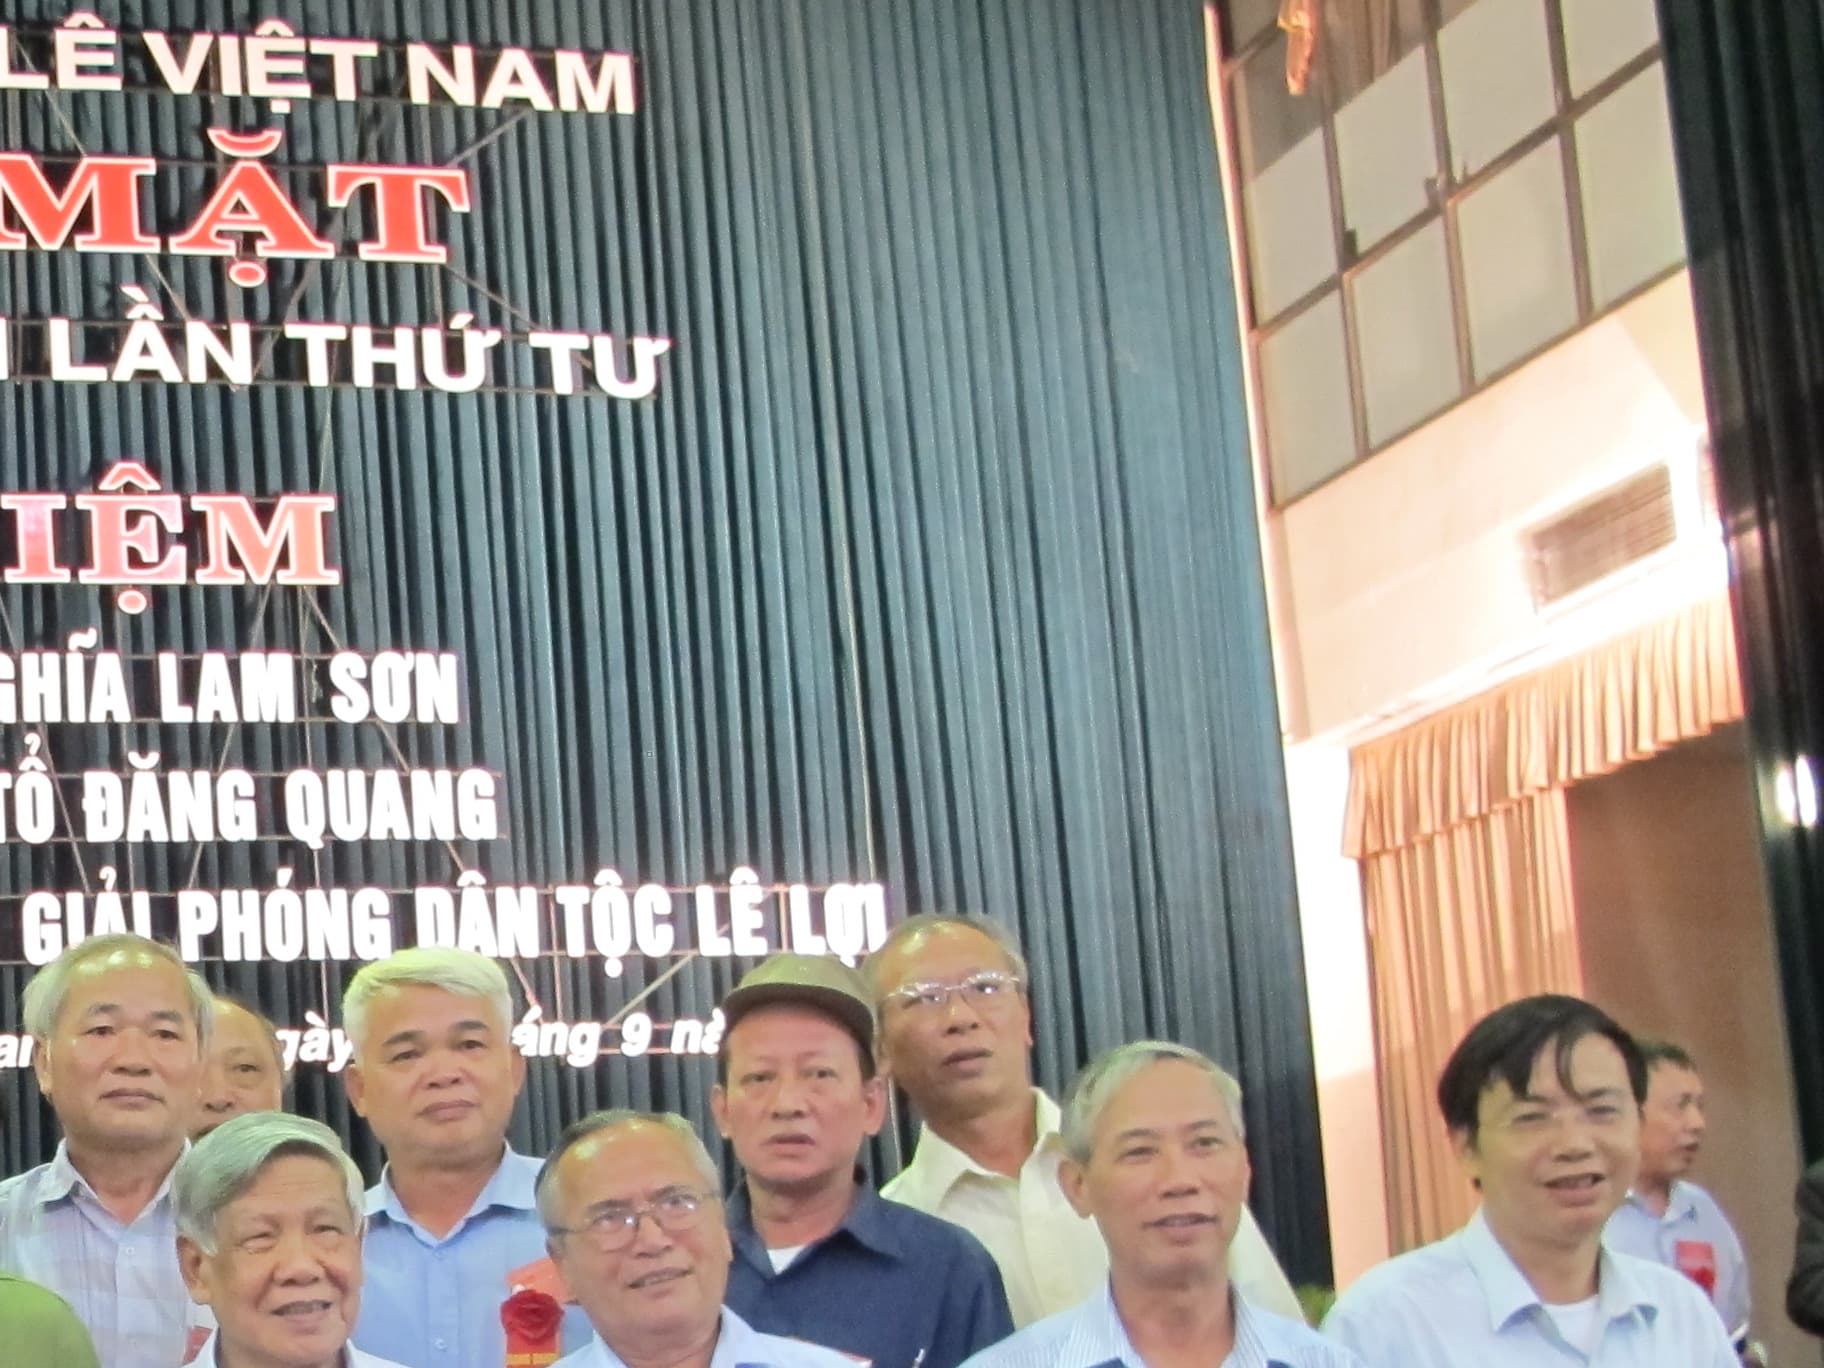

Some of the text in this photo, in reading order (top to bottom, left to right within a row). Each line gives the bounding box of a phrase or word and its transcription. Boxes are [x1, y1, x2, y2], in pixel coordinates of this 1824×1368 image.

[141, 19, 379, 113] VIỆT
[407, 43, 636, 114] NAM
[49, 284, 254, 384] LẦN
[284, 312, 502, 393] THỨ
[529, 332, 671, 400] TƯ
[159, 652, 296, 724] LAM
[328, 651, 459, 725] SƠN
[83, 751, 258, 843] ĐĂNG
[285, 768, 499, 851] QUANG
[178, 868, 393, 963] PHÓNG
[415, 869, 540, 959] DÂN
[555, 868, 674, 978] TỘC
[696, 866, 769, 957] LÊ
[621, 1012, 652, 1057] 9
